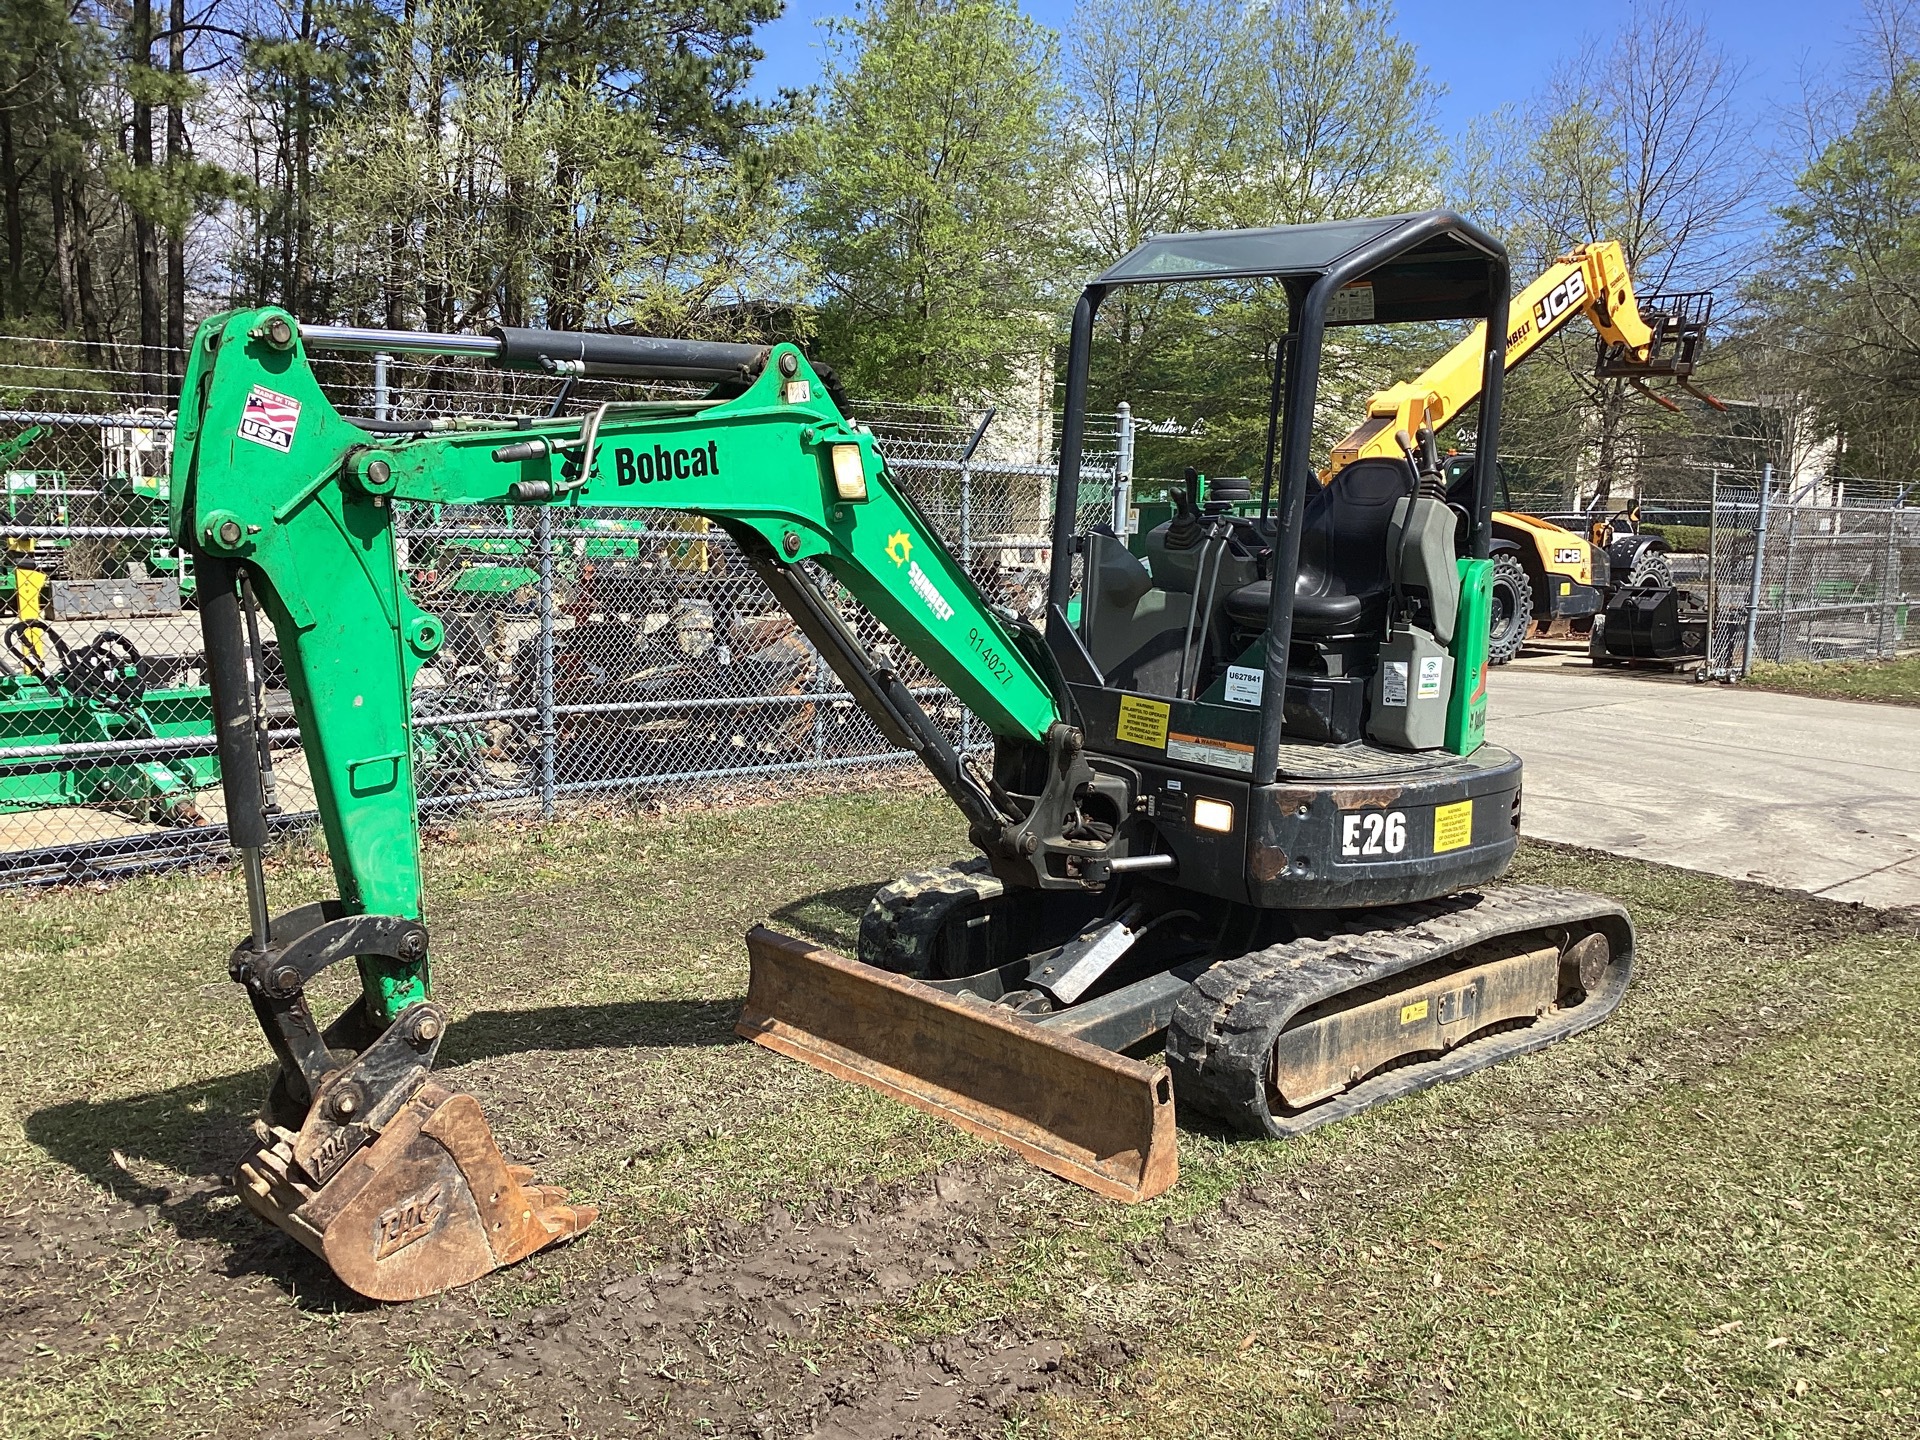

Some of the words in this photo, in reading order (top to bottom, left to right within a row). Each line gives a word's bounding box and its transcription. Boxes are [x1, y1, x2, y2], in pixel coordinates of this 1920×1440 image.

[1536, 270, 1586, 330] JCB
[1506, 319, 1531, 349] NBELT
[254, 388, 274, 401] MADE
[243, 419, 288, 447] USA
[615, 440, 720, 486] Bobcat
[1554, 549, 1581, 563] JCB
[907, 560, 955, 622] SUNBELT
[908, 578, 942, 621] RENTALS
[968, 627, 1014, 686] 914027
[1229, 671, 1261, 683] U627841
[1201, 739, 1227, 748] WARNING
[1341, 811, 1407, 856] E26
